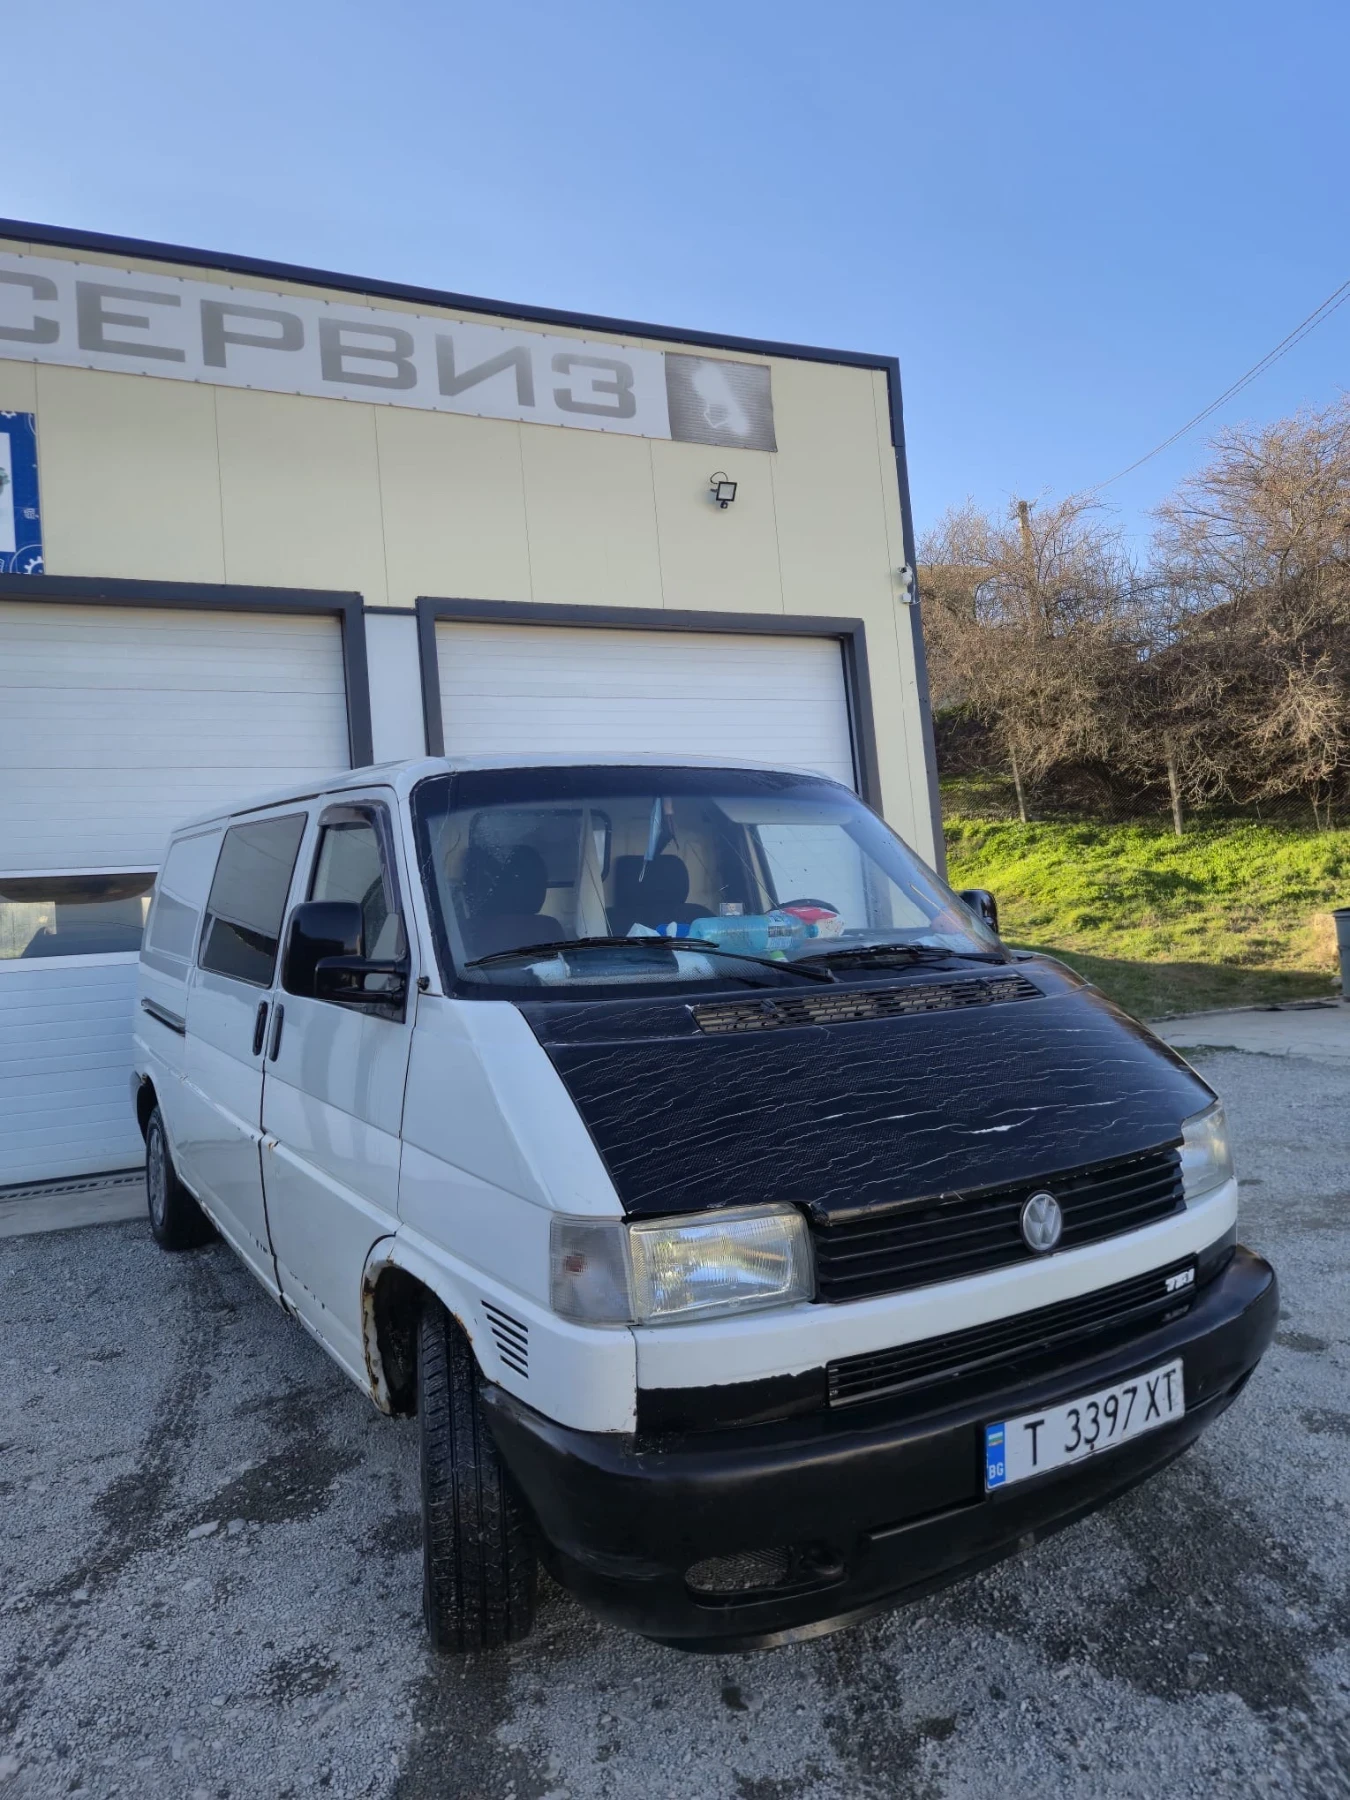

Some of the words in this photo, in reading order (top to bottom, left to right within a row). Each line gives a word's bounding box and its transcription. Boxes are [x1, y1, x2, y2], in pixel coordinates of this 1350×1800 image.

[1024, 1418, 1045, 1466] T
[1065, 1386, 1138, 1453] 3397
[988, 1462, 1004, 1480] BG
